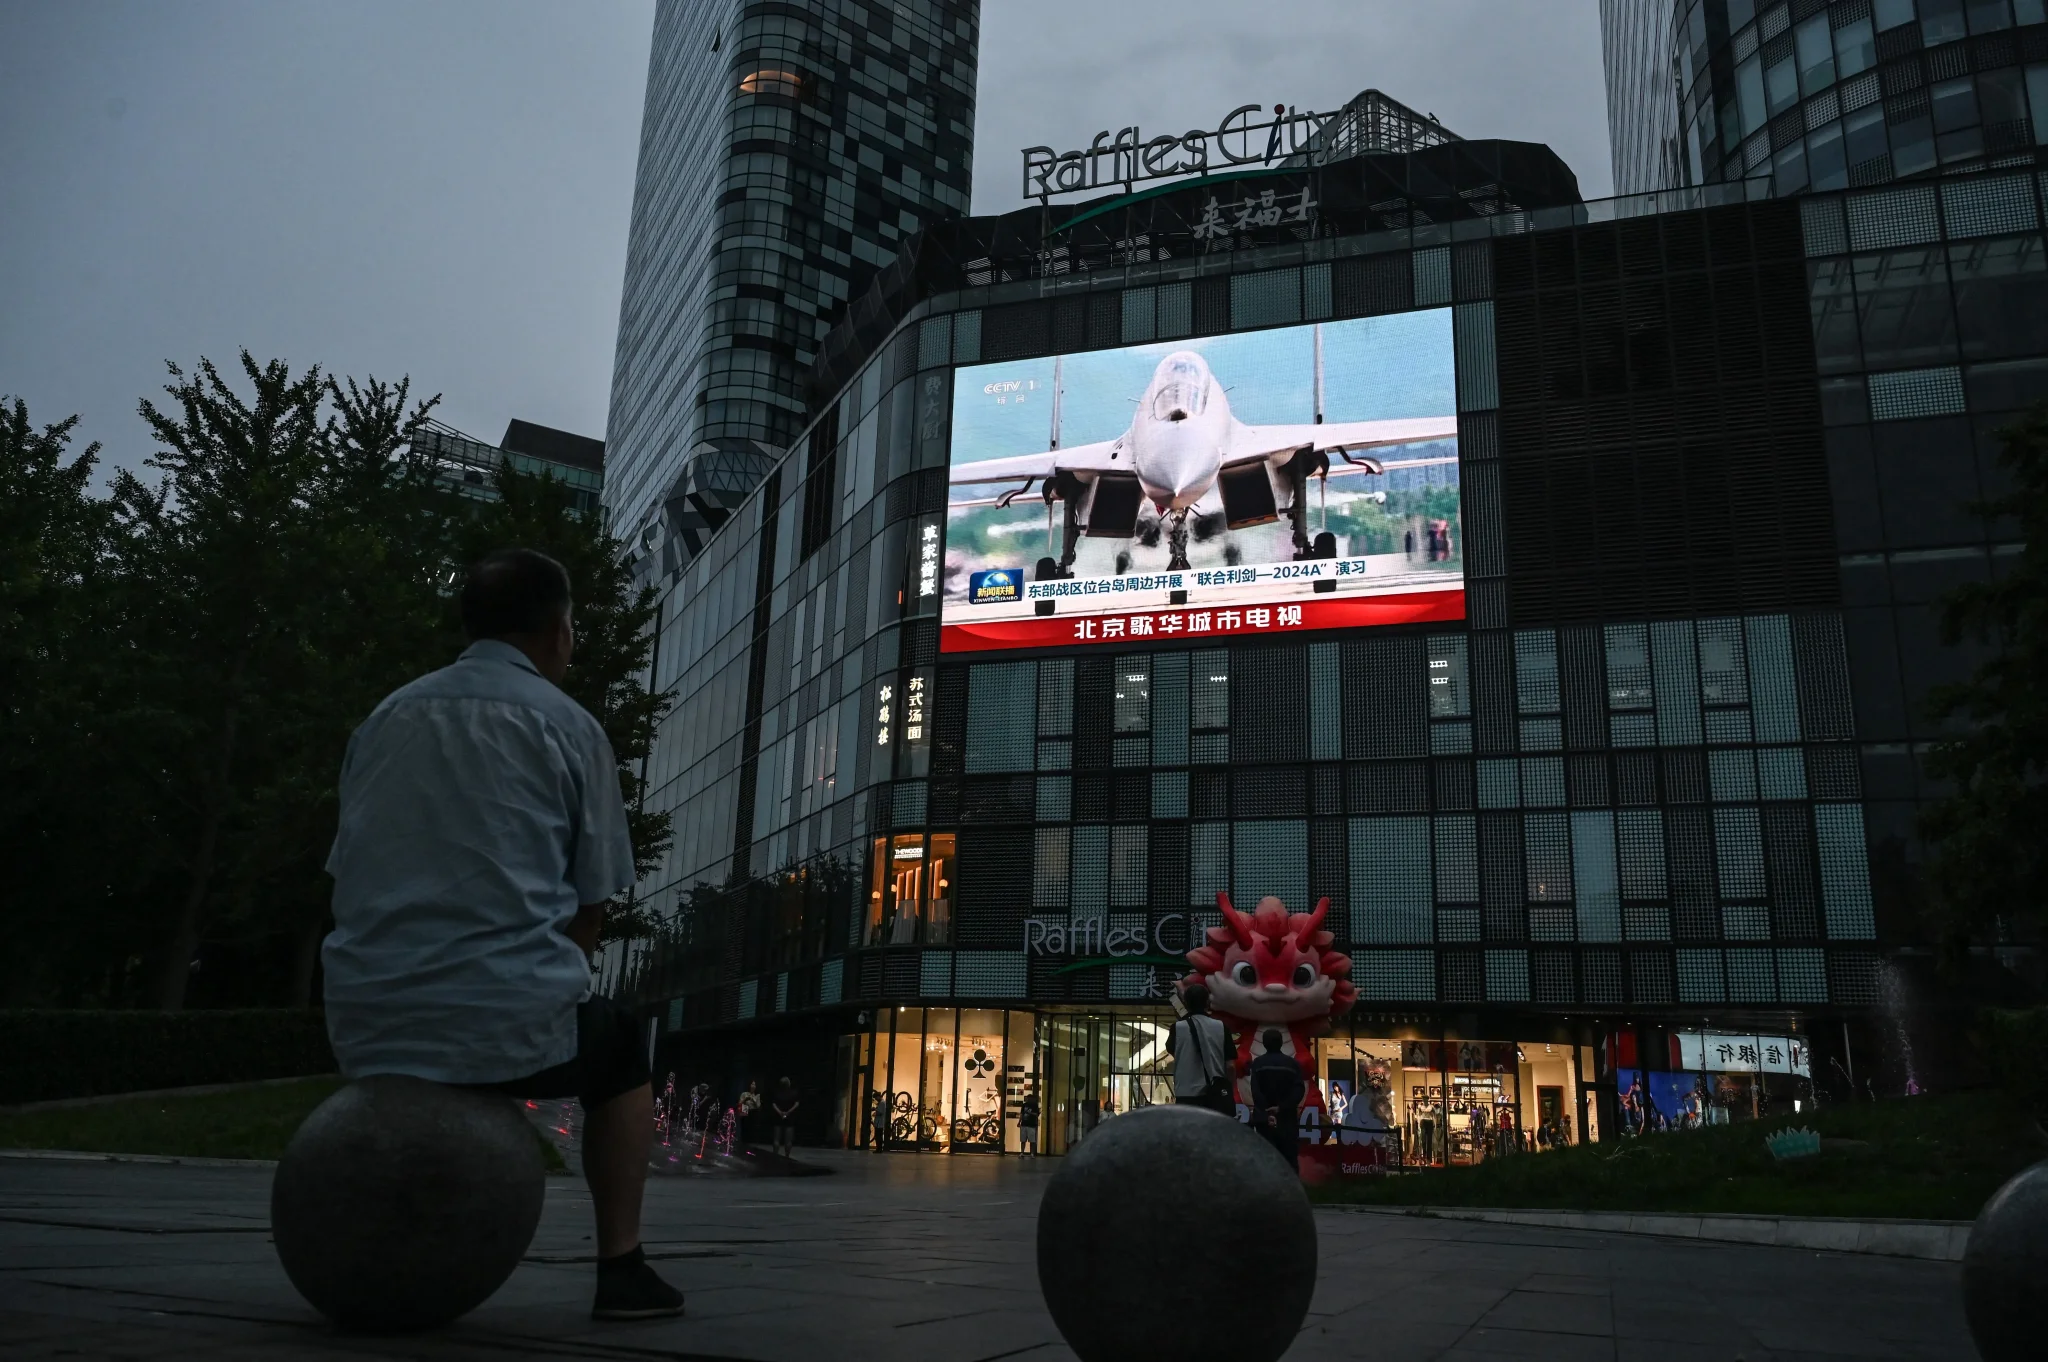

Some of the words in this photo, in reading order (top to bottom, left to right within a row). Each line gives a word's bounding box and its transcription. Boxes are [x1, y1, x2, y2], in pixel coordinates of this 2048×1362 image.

[1021, 126, 1208, 199] Raffles
[1217, 103, 1349, 167] City
[984, 380, 1022, 394] CCTV
[996, 394, 1025, 405] 综合
[924, 375, 942, 440] 费大厨
[976, 585, 1015, 598] 新闻联播
[1074, 605, 1303, 640] 北京歌华城市电视
[907, 676, 924, 740] 苏式汤面
[1023, 915, 1149, 957] Raffles
[1154, 914, 1209, 956] Cit
